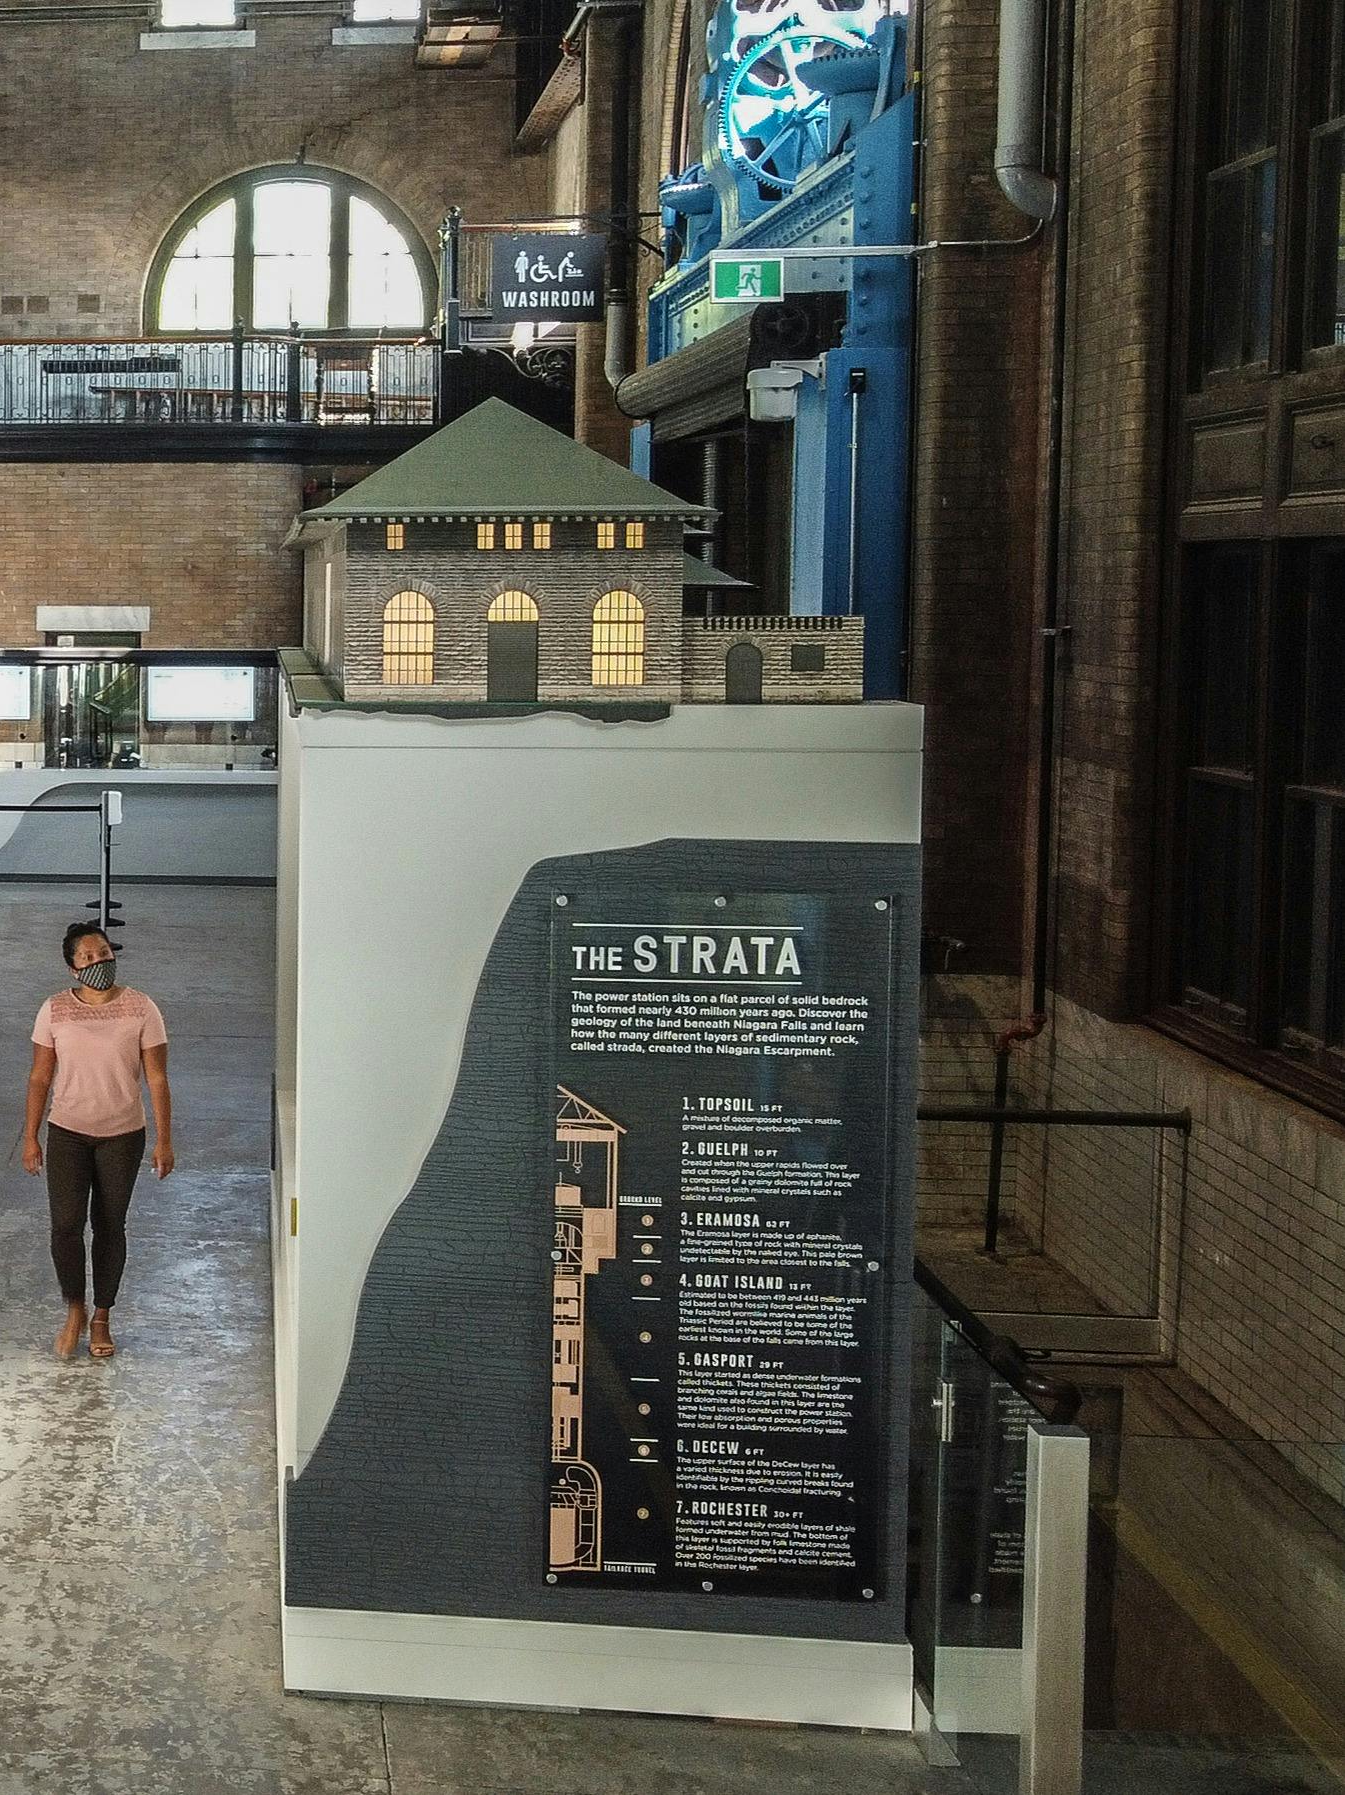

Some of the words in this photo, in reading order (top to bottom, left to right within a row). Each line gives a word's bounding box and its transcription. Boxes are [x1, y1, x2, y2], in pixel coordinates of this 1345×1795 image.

[502, 290, 594, 308] WASHROOM
[571, 946, 622, 971] THE
[633, 935, 802, 975] STRATA
[573, 991, 592, 999] The
[594, 993, 629, 1002] power
[631, 992, 669, 1001] station
[671, 993, 690, 1001] sits
[719, 994, 738, 1002] flat
[740, 994, 775, 1005] parcel
[777, 995, 789, 1003] of
[791, 995, 819, 1004] solid
[821, 996, 868, 1005] bedrock
[571, 1003, 594, 1012] that
[596, 1004, 636, 1013] formed
[638, 1005, 672, 1016] nearly
[674, 1005, 697, 1014] 430
[699, 1006, 736, 1015] million
[738, 1009, 769, 1017] years
[770, 1010, 795, 1018] ago.
[798, 1008, 846, 1017] Discover
[849, 1009, 868, 1017] the
[570, 1016, 617, 1027] geology
[620, 1017, 632, 1026] of
[634, 1017, 653, 1026] the
[656, 1018, 681, 1026] land
[684, 1018, 730, 1027] beneath
[733, 1019, 777, 1030] Niagara
[780, 1020, 807, 1029] Falls
[809, 1021, 832, 1030] and
[834, 1021, 864, 1030] learn
[570, 1028, 594, 1037] how
[597, 1029, 616, 1038] the
[618, 1032, 650, 1040] many
[652, 1030, 701, 1039] different
[704, 1031, 737, 1042] layers
[740, 1032, 753, 1040] of
[755, 1032, 826, 1044] sedimentary
[830, 1034, 858, 1044] rock,
[570, 1041, 604, 1050] called
[606, 1042, 645, 1052] strada,
[648, 1043, 691, 1052] created
[694, 1044, 713, 1052] the
[716, 1044, 760, 1055] Niagara
[763, 1045, 834, 1057] Escarpment.
[682, 1097, 695, 1111] 1.
[699, 1098, 754, 1112] TOPSOIL
[760, 1104, 769, 1112] 15
[682, 1142, 694, 1155] 2.
[697, 1142, 748, 1156] GUELPH
[680, 1212, 693, 1226] 3.
[696, 1213, 760, 1228] ERAMOSA
[679, 1274, 692, 1288] 4.
[695, 1274, 729, 1289] GOAT
[734, 1275, 783, 1290] ISLAND
[800, 1283, 812, 1291] FT
[678, 1352, 690, 1366] 5.
[694, 1353, 753, 1368] GASPORT
[676, 1439, 689, 1453] 6.
[692, 1440, 739, 1455] DECEW
[745, 1448, 751, 1456] 6
[676, 1500, 689, 1514] 7.
[692, 1501, 768, 1518] ROCHESTER
[792, 1511, 803, 1519] FT
